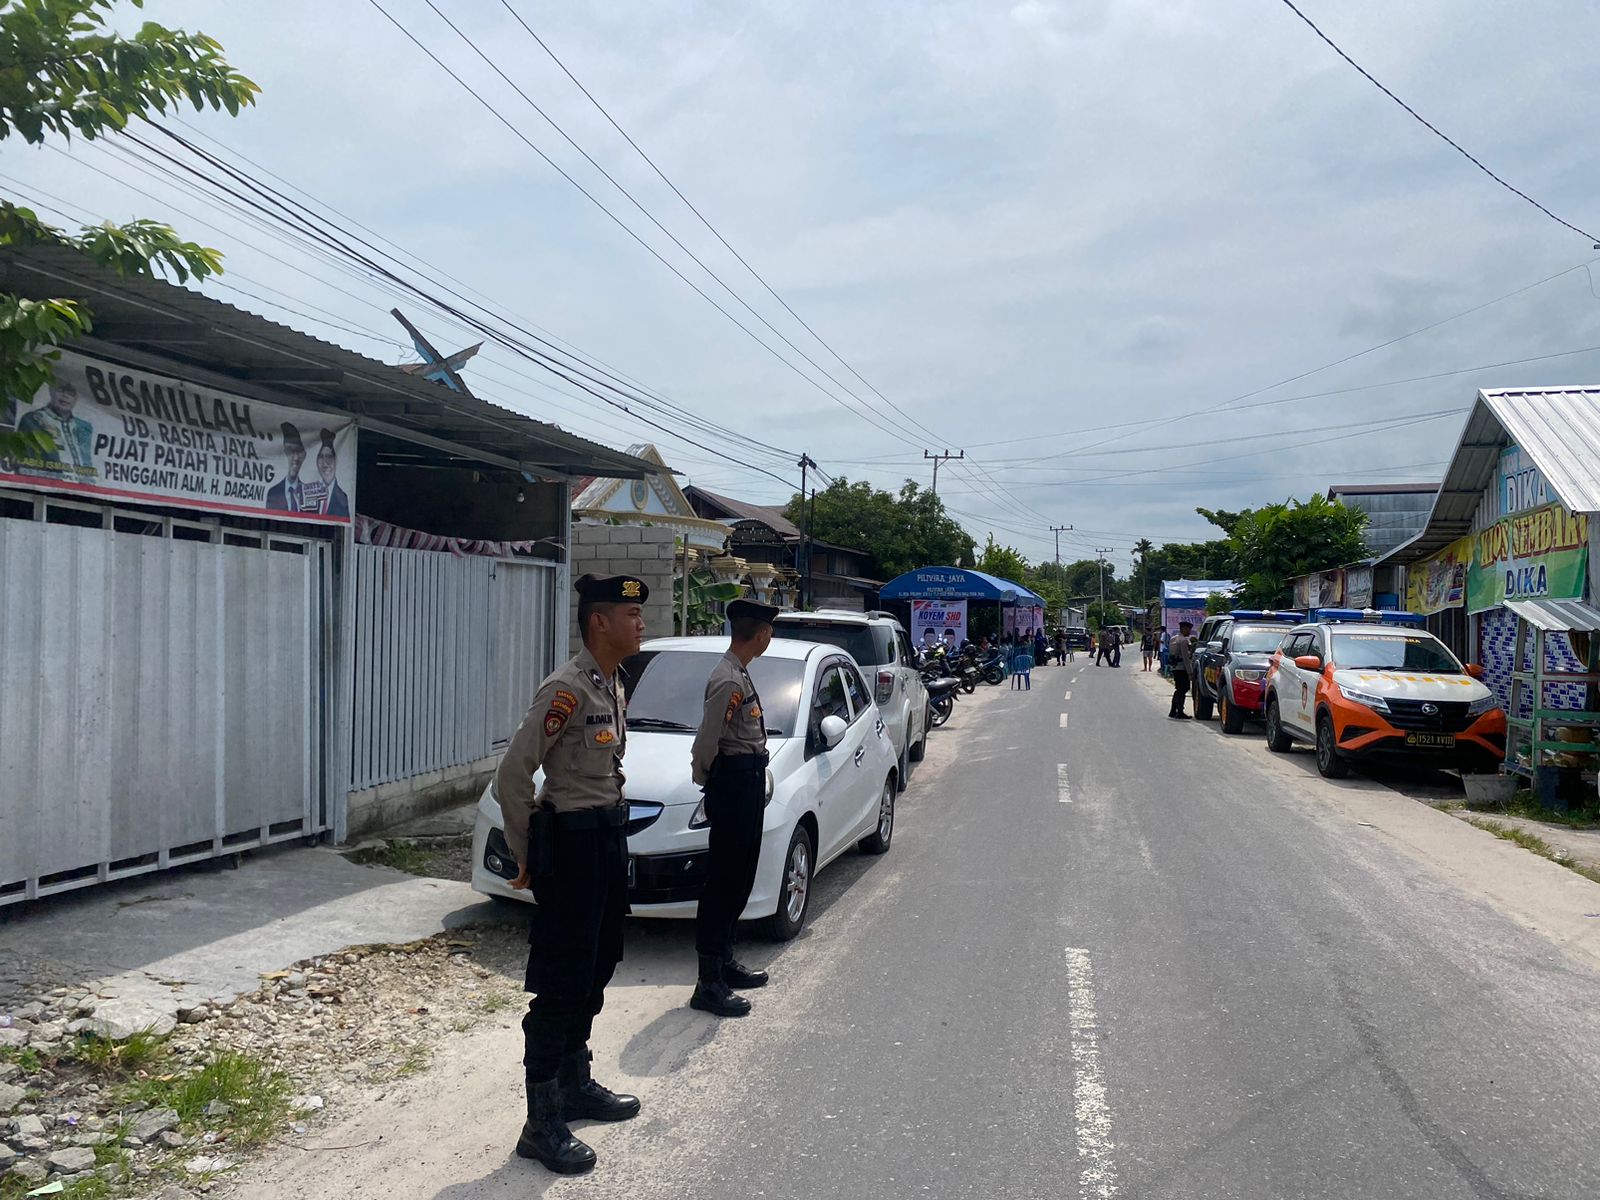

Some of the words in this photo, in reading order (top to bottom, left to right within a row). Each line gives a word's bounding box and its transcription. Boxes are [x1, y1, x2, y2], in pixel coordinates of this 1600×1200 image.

[94, 433, 149, 463] PIJAT
[154, 444, 207, 473] PATAH
[212, 455, 275, 483] TULANG
[121, 415, 155, 440] UD.
[158, 423, 217, 453] RASITA
[221, 436, 259, 460] JAYA
[105, 461, 179, 490] PENGGANTI
[181, 474, 207, 494] ALM.
[210, 478, 220, 496] H.
[224, 480, 265, 502] DARSANI
[1505, 467, 1550, 514] DIKA
[1480, 520, 1509, 569] KIOS
[949, 575, 966, 584] JAYA
[1504, 563, 1548, 599] DIKA
